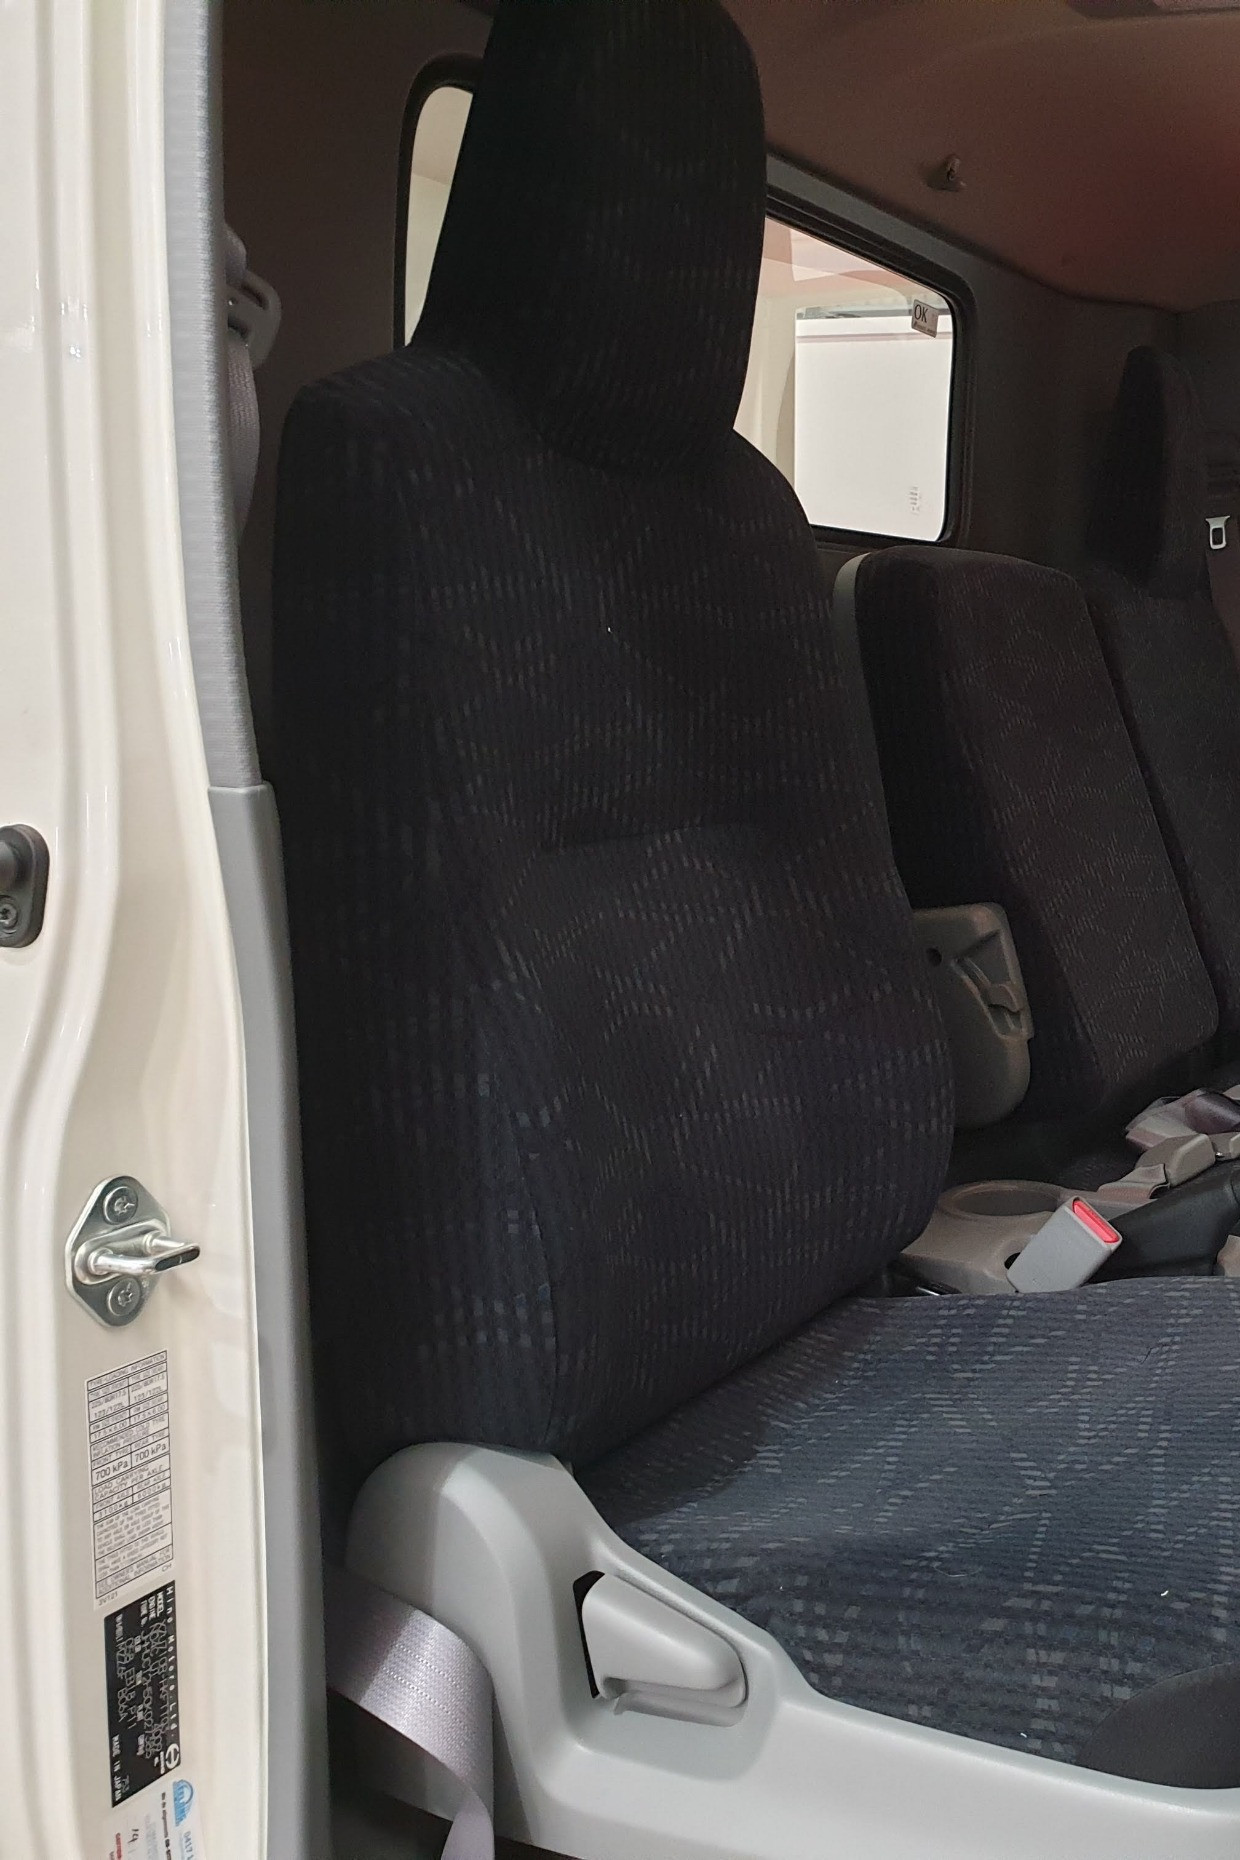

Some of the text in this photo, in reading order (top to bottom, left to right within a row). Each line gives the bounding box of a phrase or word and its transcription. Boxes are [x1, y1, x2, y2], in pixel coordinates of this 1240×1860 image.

[914, 304, 928, 323] OK
[134, 1440, 166, 1463] 700 kPa
[95, 1458, 128, 1481] 700 kPa
[113, 1774, 122, 1801] JAPAN
